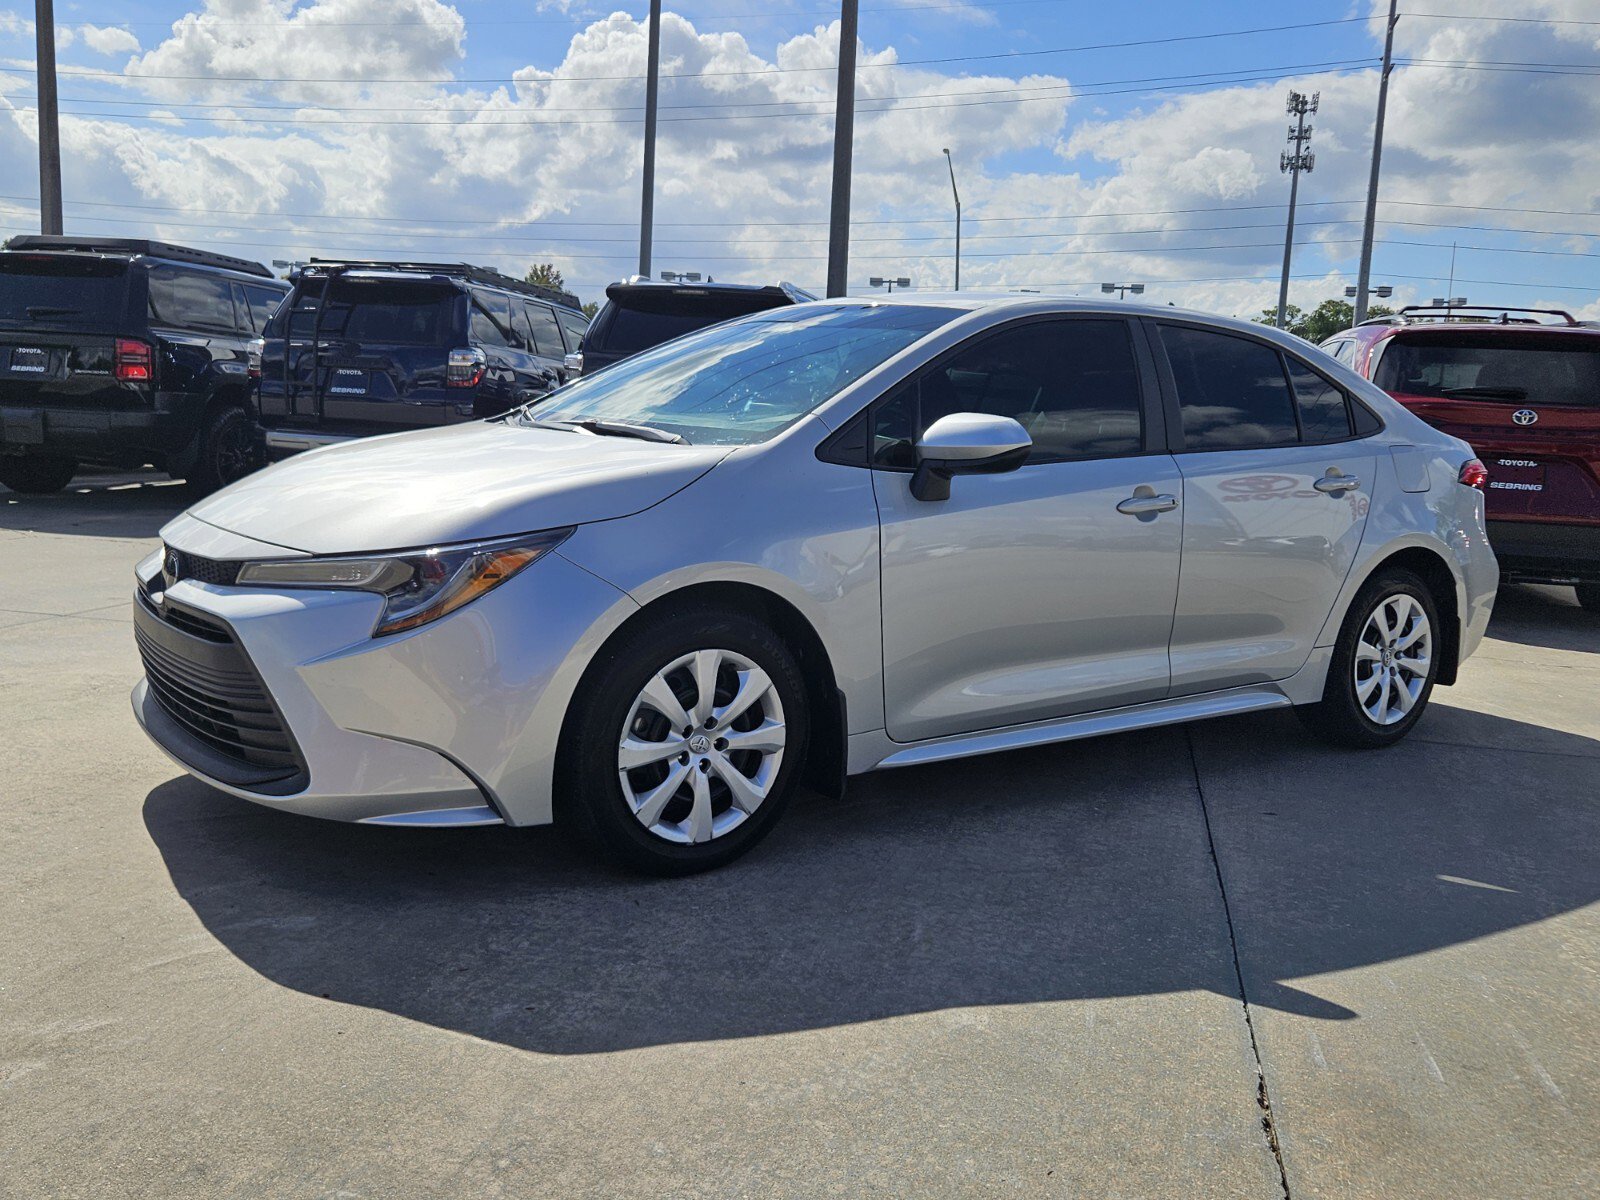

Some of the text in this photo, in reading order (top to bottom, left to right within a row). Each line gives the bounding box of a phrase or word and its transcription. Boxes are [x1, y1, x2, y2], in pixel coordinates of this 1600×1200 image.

[331, 386, 366, 394] SEBRING
[1499, 459, 1537, 467] TOYOTA
[1490, 482, 1543, 491] SEBRING
